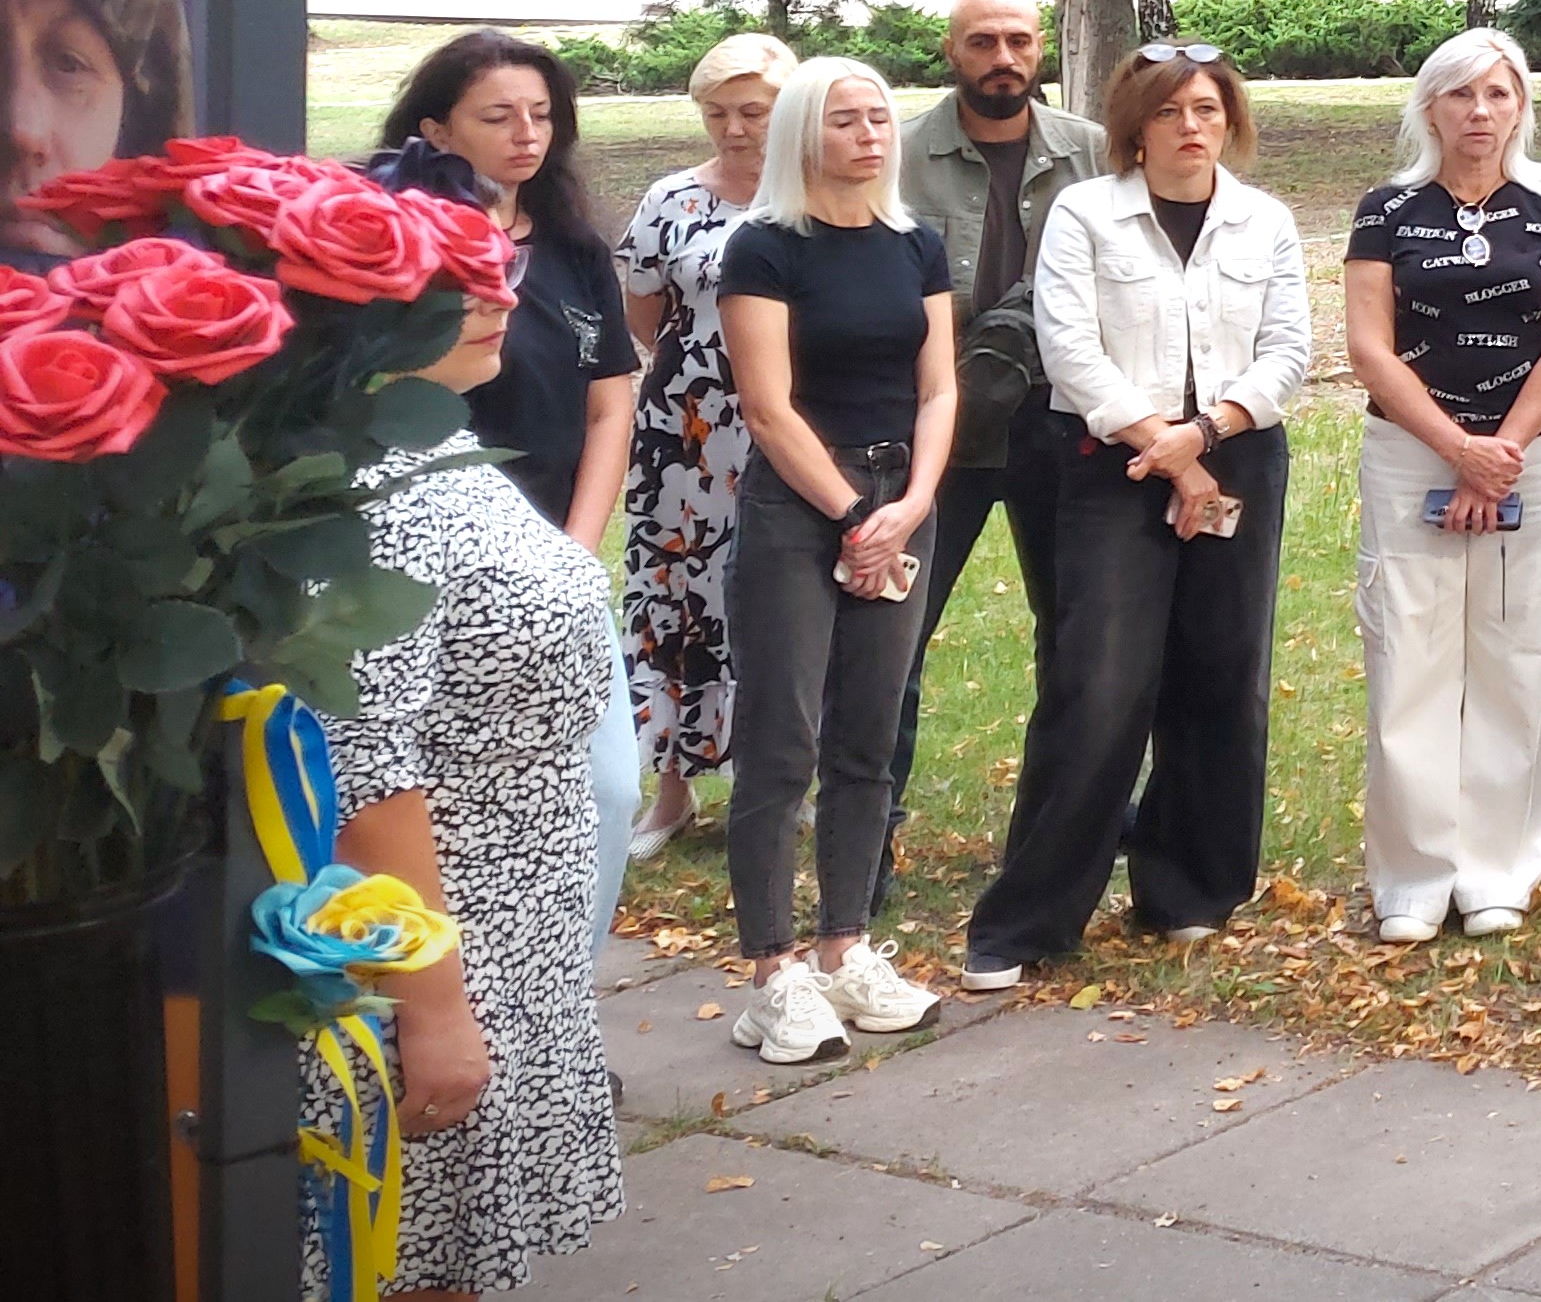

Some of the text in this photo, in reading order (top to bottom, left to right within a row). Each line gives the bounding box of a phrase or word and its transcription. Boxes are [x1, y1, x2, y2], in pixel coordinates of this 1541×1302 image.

[1396, 226, 1458, 241] FASHION
[1422, 255, 1470, 269] CATWA
[1464, 279, 1531, 304] BLOGGER
[1411, 301, 1440, 319] ICON
[1457, 334, 1519, 347] STYLISH
[1475, 361, 1532, 393] BLOGGER
